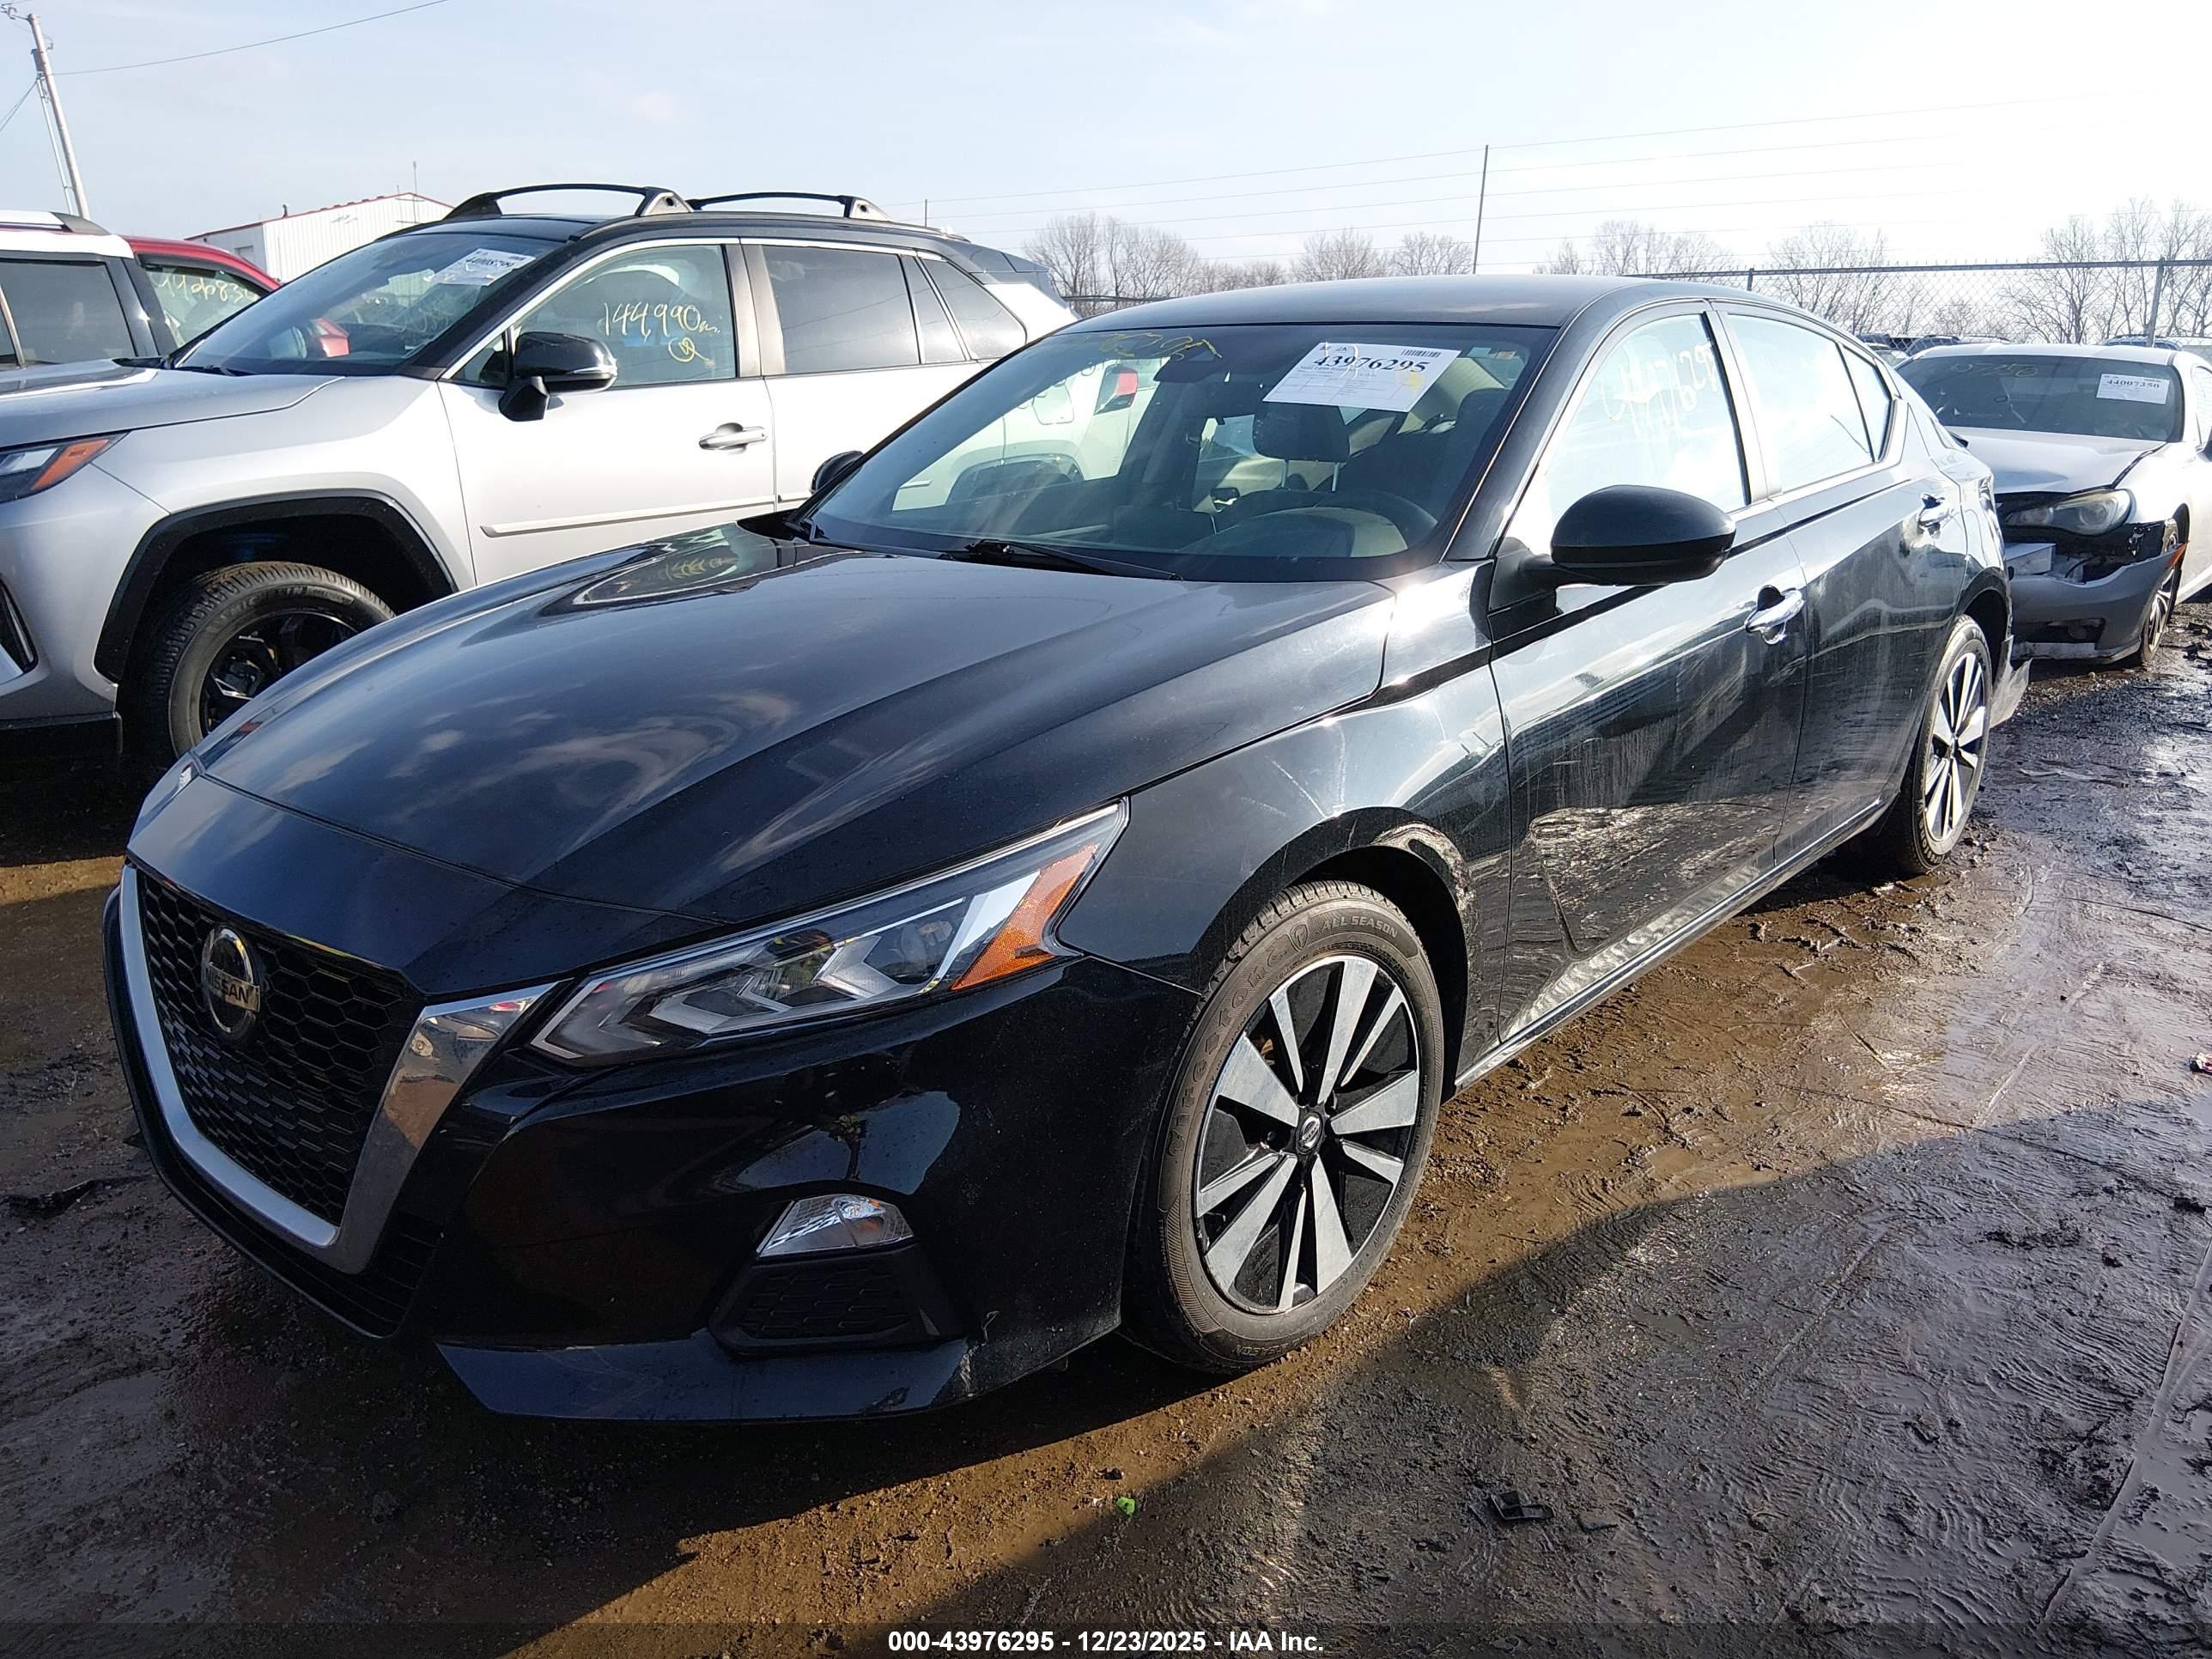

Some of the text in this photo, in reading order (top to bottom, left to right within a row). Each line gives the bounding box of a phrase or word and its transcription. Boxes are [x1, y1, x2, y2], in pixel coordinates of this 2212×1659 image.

[1313, 356, 1431, 373] 43976295
[2106, 380, 2160, 389] 44007350
[1321, 915, 1398, 938] ALL SEASON
[205, 965, 249, 1003] NISSAN
